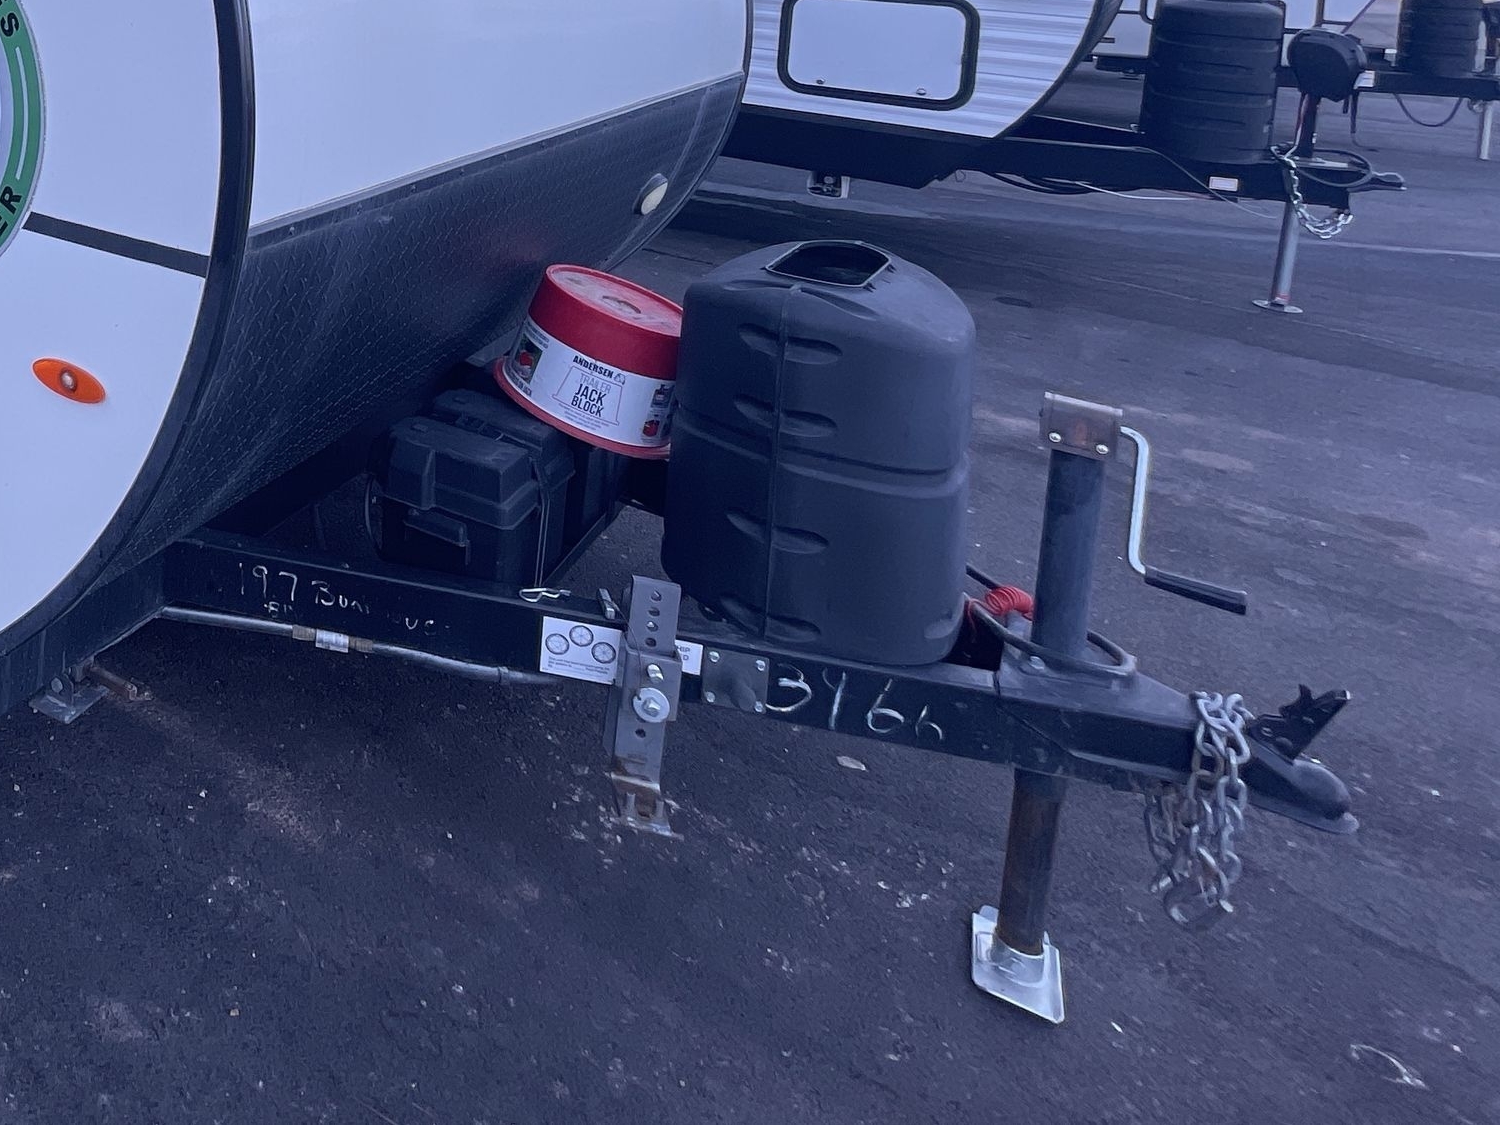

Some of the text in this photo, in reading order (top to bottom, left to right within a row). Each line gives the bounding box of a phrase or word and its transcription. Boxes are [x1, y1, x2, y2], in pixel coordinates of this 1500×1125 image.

[573, 355, 614, 378] ANDERSEN
[575, 383, 607, 406] JACK
[579, 372, 611, 394] TRAILER
[571, 395, 604, 418] BLOCK
